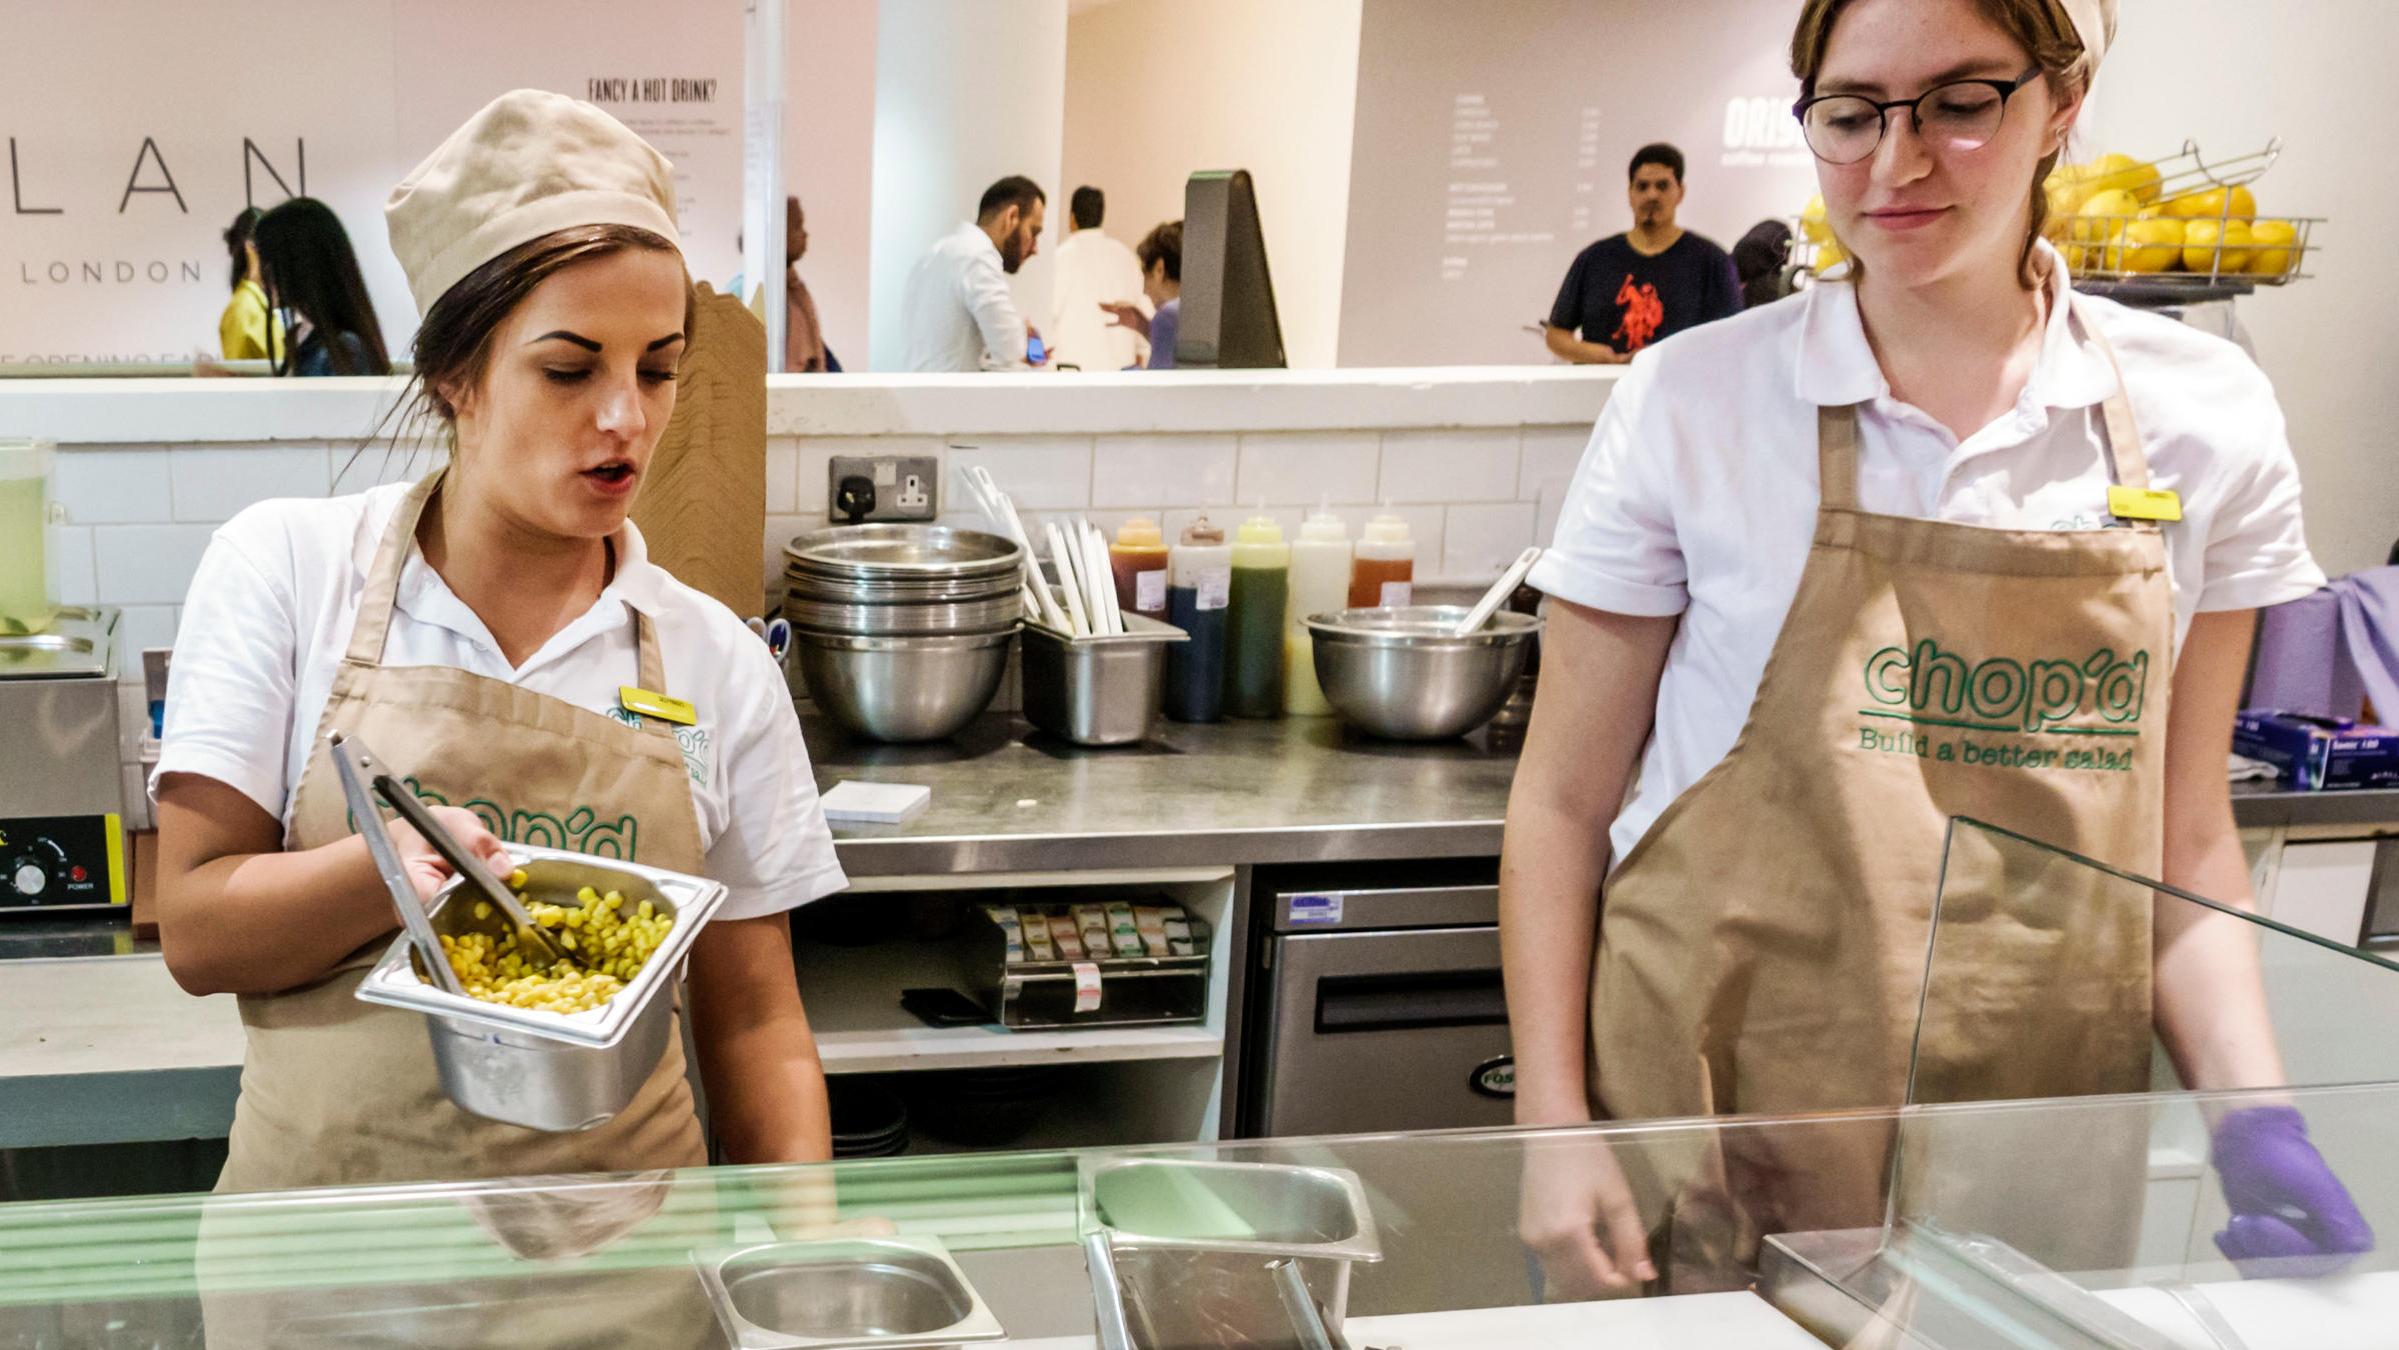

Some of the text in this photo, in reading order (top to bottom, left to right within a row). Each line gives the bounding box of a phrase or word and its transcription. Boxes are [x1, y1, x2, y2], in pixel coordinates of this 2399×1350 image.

[588, 79, 718, 102] FANCY A HOT DRINK?
[21, 261, 201, 284] LONDON
[1864, 638, 2148, 732] chop'd
[1858, 727, 2134, 771] Build a better salad
[67, 882, 95, 891] POWER
